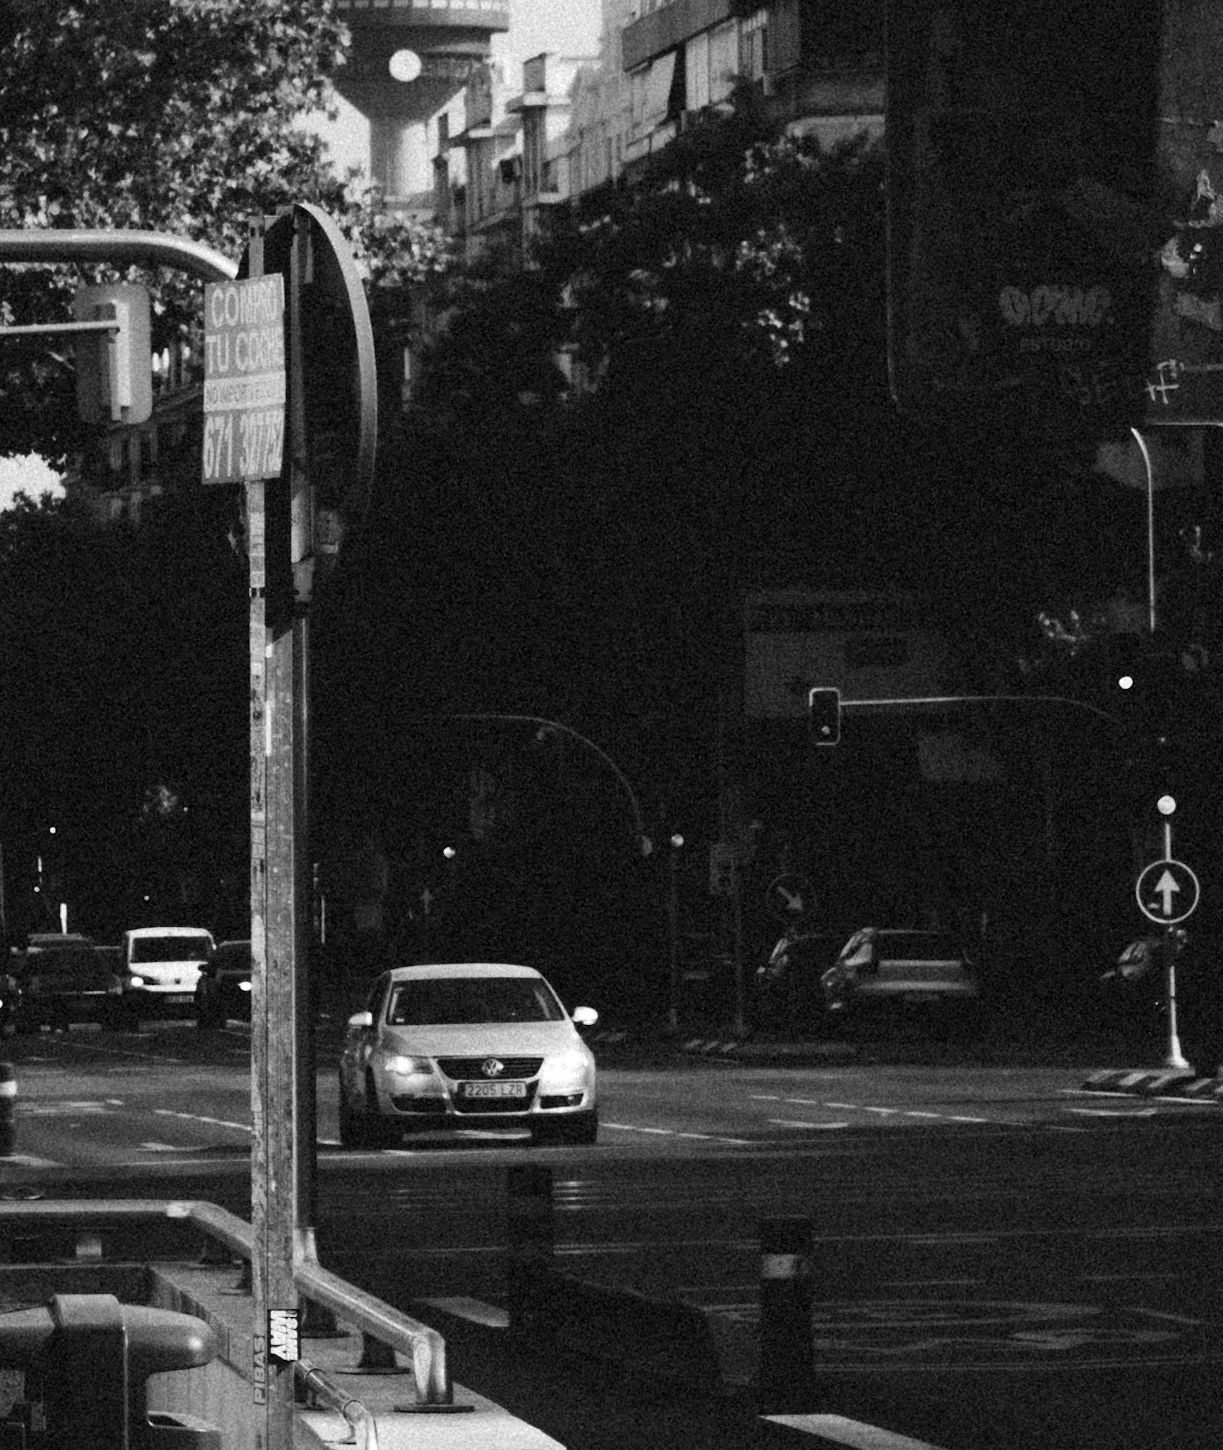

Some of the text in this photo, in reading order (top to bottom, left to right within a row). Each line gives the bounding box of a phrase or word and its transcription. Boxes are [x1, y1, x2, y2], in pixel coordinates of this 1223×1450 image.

[211, 281, 278, 328] COMPRO
[205, 326, 285, 374] TU COCHE
[203, 413, 233, 479] 671
[467, 1083, 523, 1097] 2205 LZR
[270, 1309, 287, 1361] WAY
[253, 1334, 266, 1405] PIBAS
